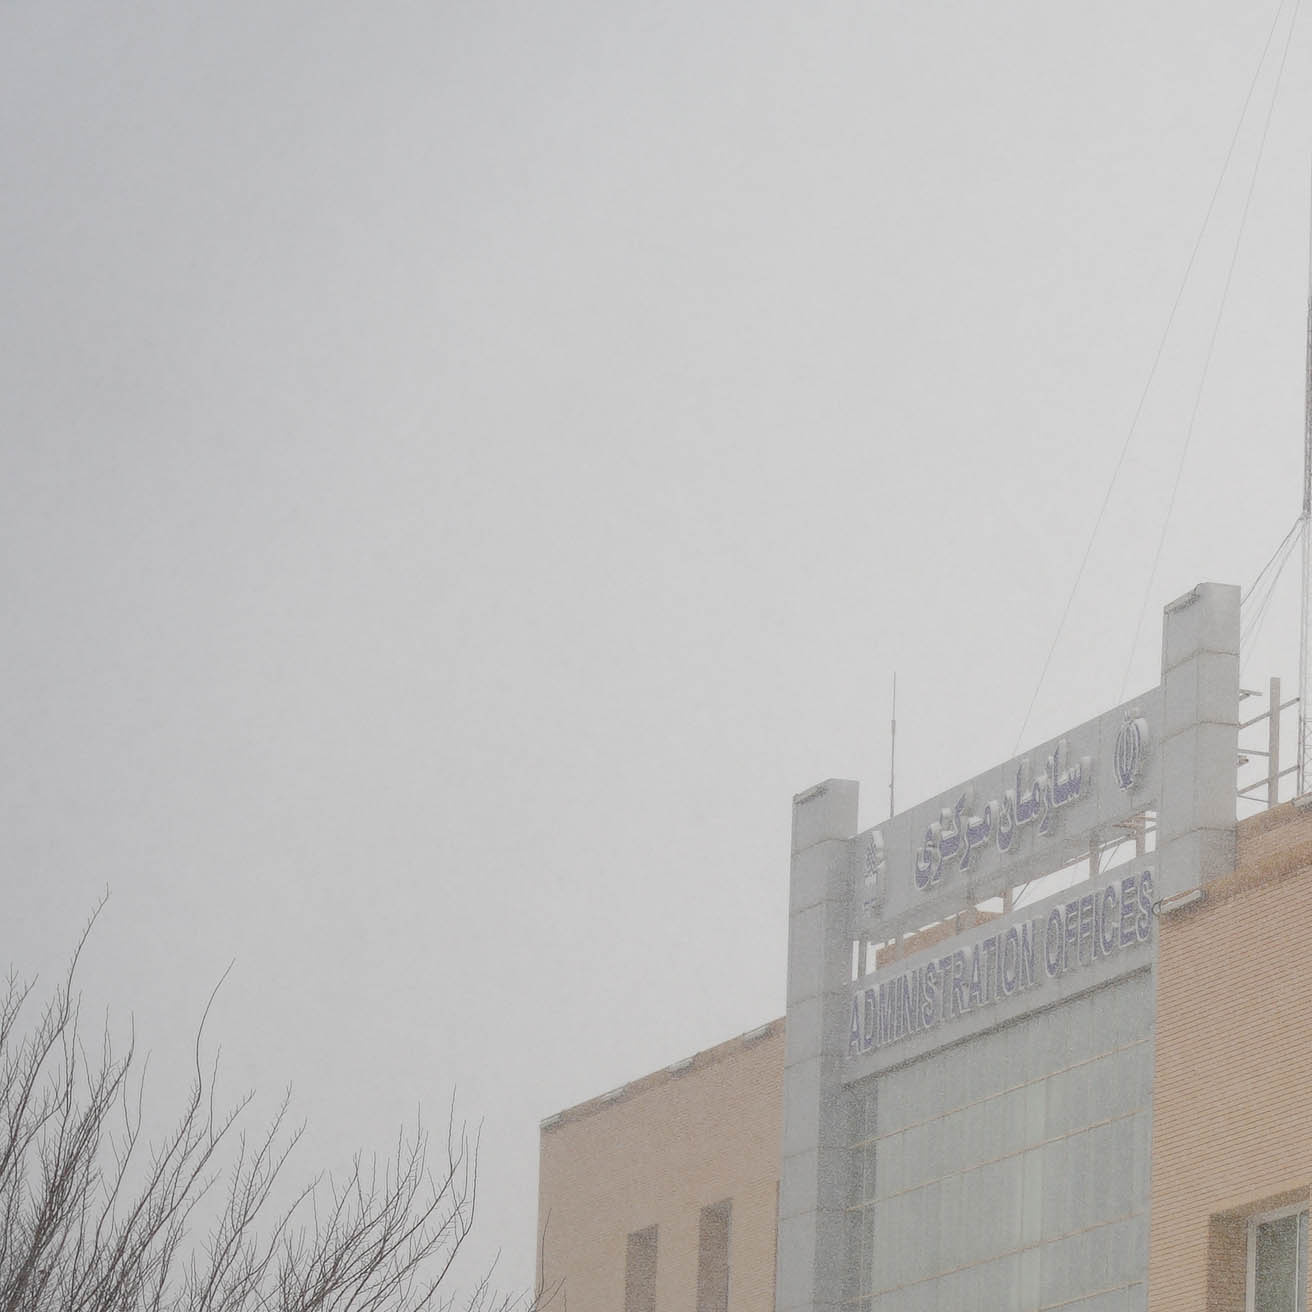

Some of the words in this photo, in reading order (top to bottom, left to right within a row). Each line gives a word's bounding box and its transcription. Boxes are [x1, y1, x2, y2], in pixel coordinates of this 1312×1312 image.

[914, 788, 993, 890] مرکزی
[998, 740, 1085, 854] سازمان
[851, 919, 1037, 1056] ADMINISTRATION
[1045, 871, 1153, 979] OFFICES
